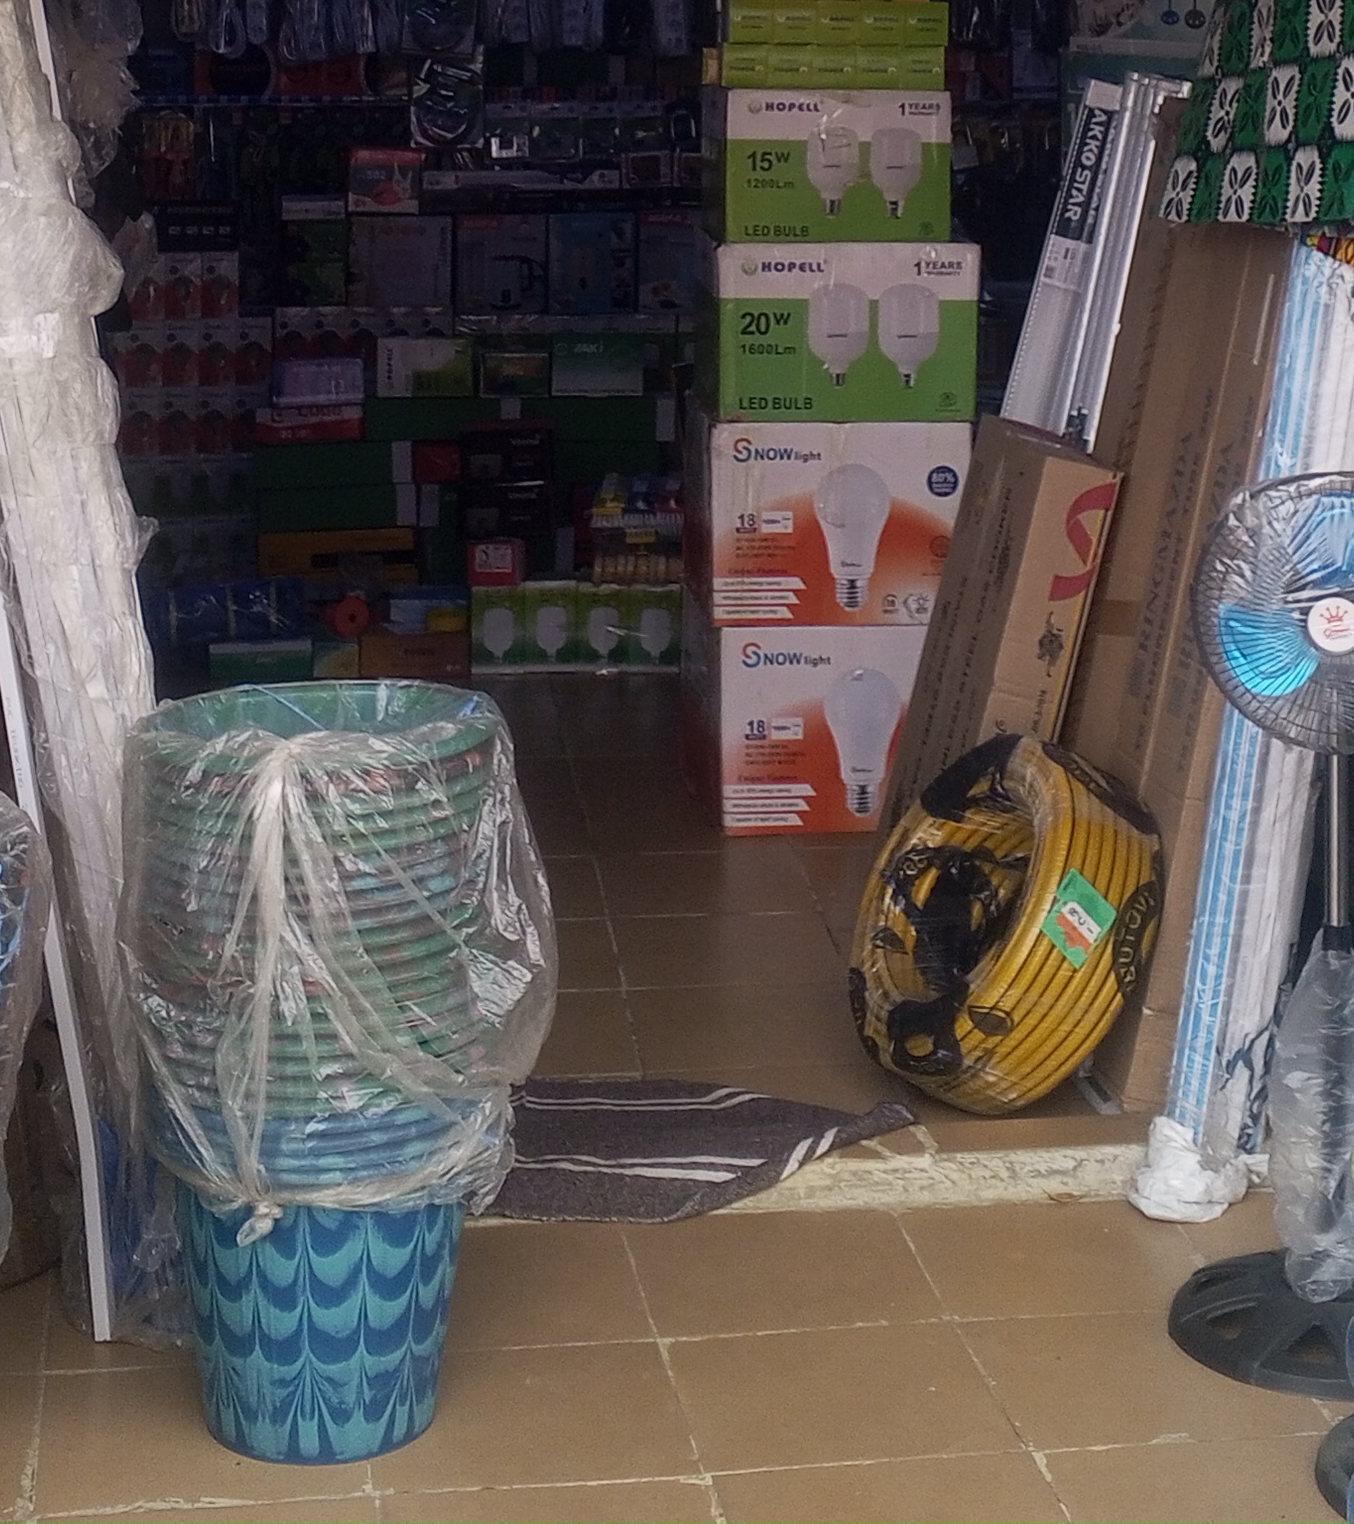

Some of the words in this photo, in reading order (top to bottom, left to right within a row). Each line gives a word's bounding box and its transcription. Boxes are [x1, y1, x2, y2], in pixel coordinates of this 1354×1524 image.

[765, 101, 821, 113] HOPELL
[898, 102, 906, 117] 1
[1078, 110, 1108, 167] AKKO
[1062, 169, 1090, 221] STAR
[744, 226, 770, 237] LED
[773, 226, 810, 238] BULB
[761, 261, 825, 274] HOPELL
[914, 261, 923, 276] 1
[924, 261, 963, 271] YEARS
[738, 397, 768, 410] LED
[772, 397, 814, 410] BULB
[737, 513, 757, 528] 18
[747, 719, 766, 734] 18
